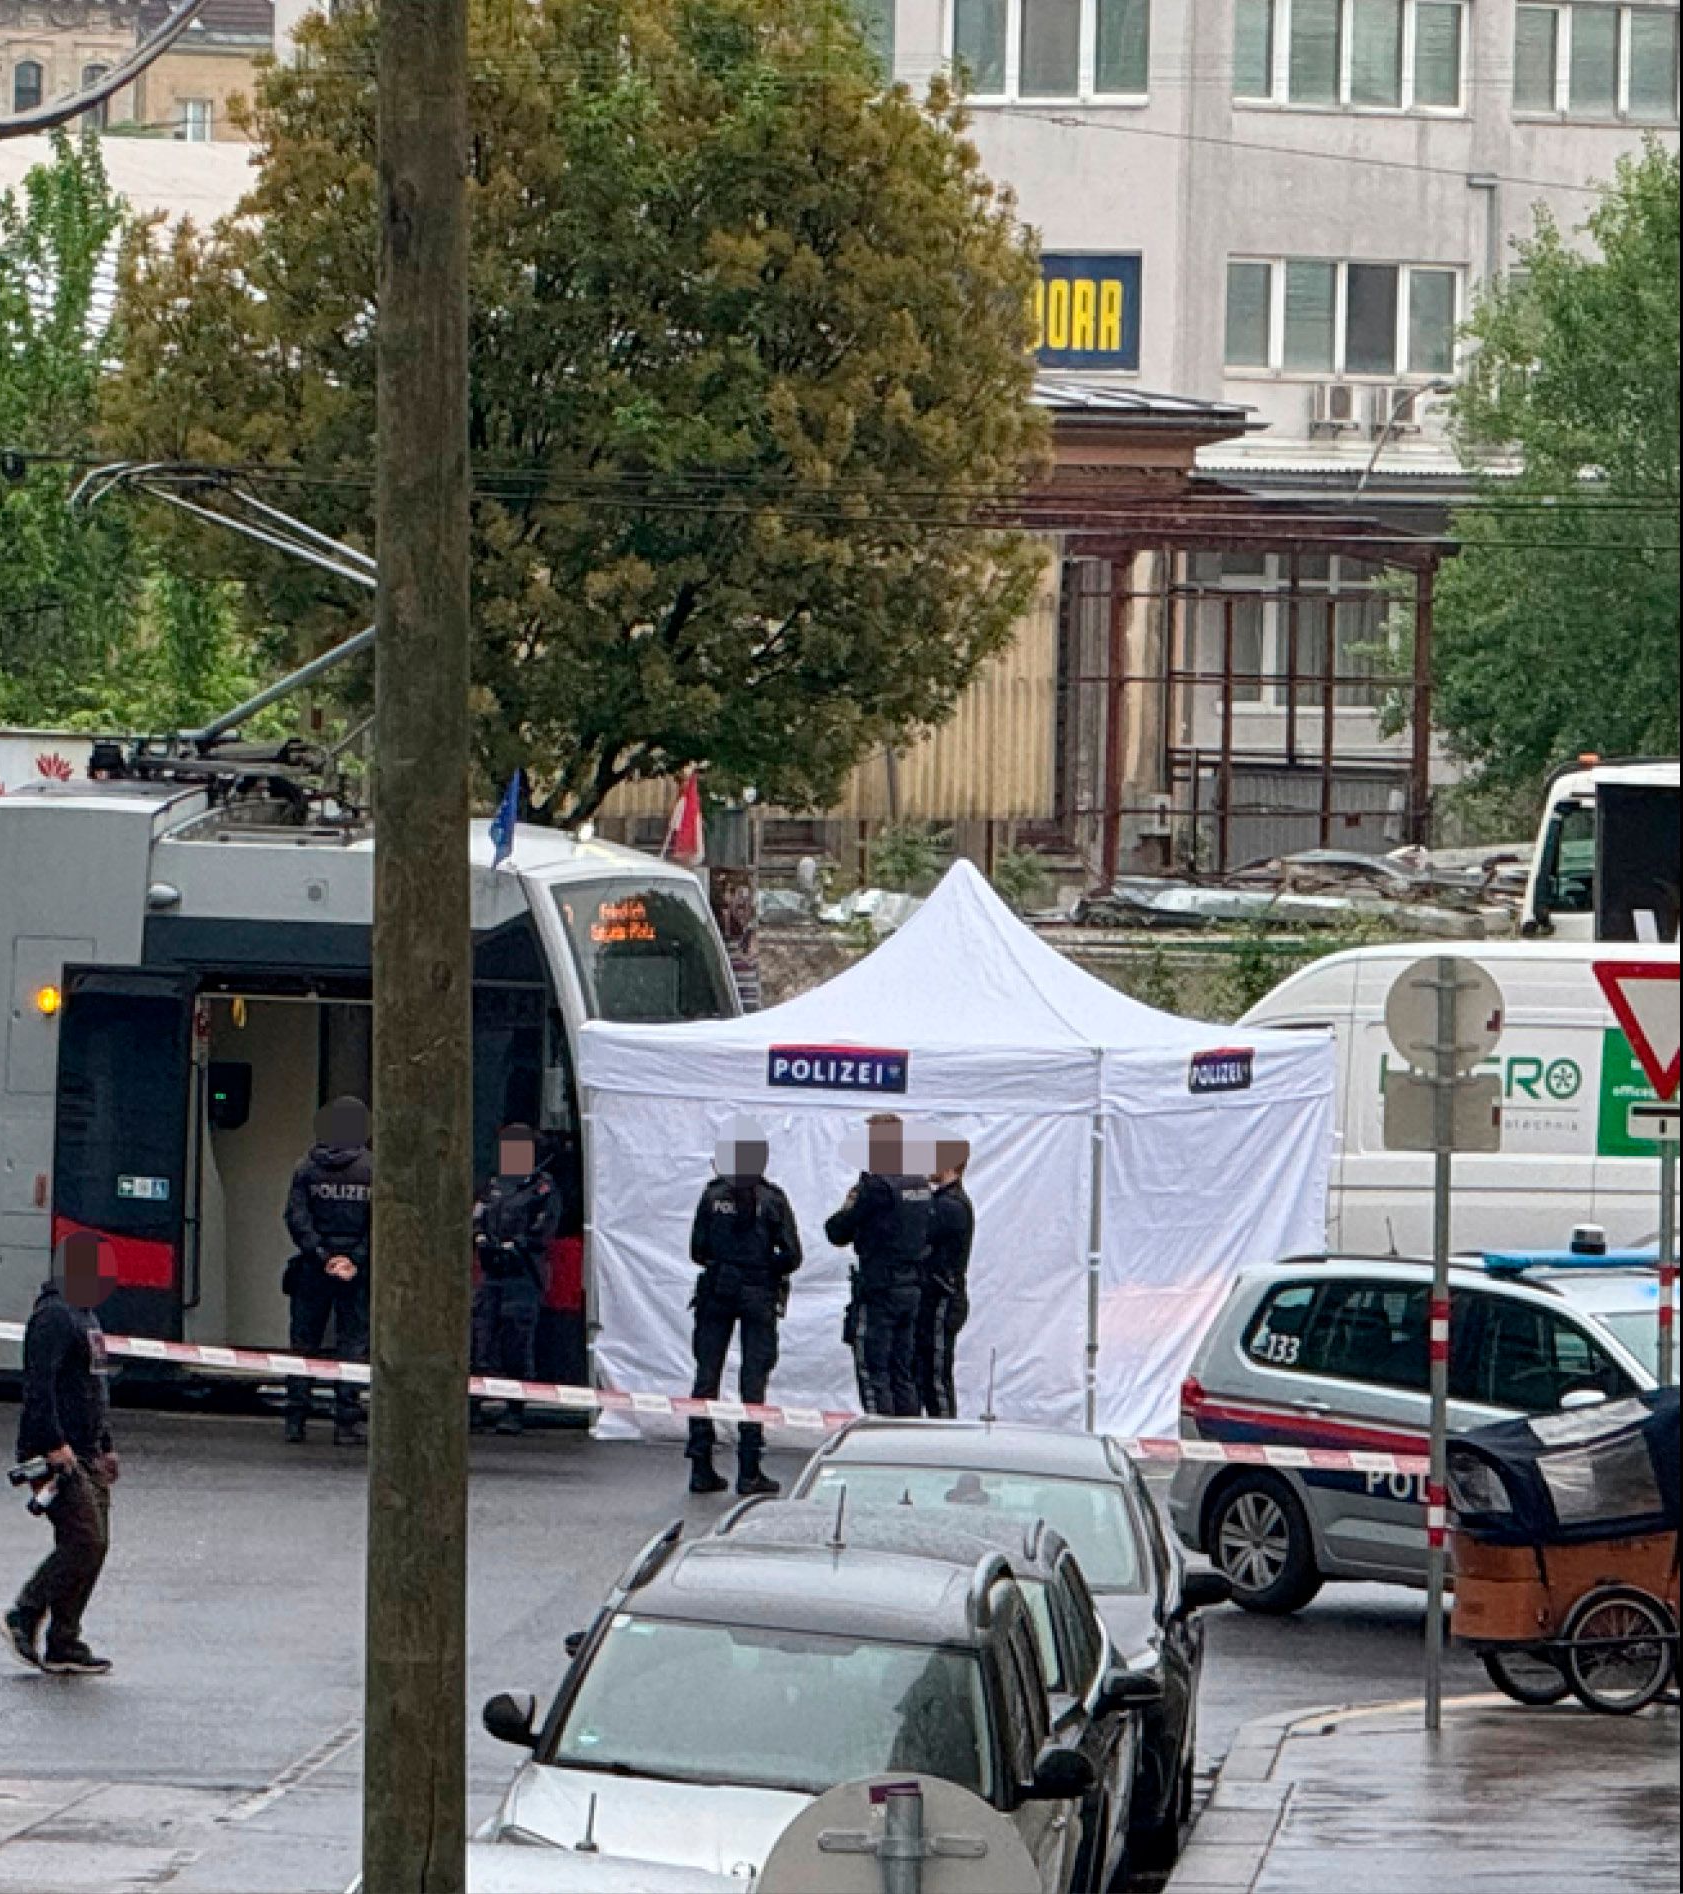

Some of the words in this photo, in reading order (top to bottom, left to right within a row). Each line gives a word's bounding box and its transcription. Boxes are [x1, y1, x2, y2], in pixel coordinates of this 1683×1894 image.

[773, 1057, 883, 1085] POLIZEI
[1191, 1061, 1243, 1087] POLIZEI
[1267, 1333, 1301, 1365] 133
